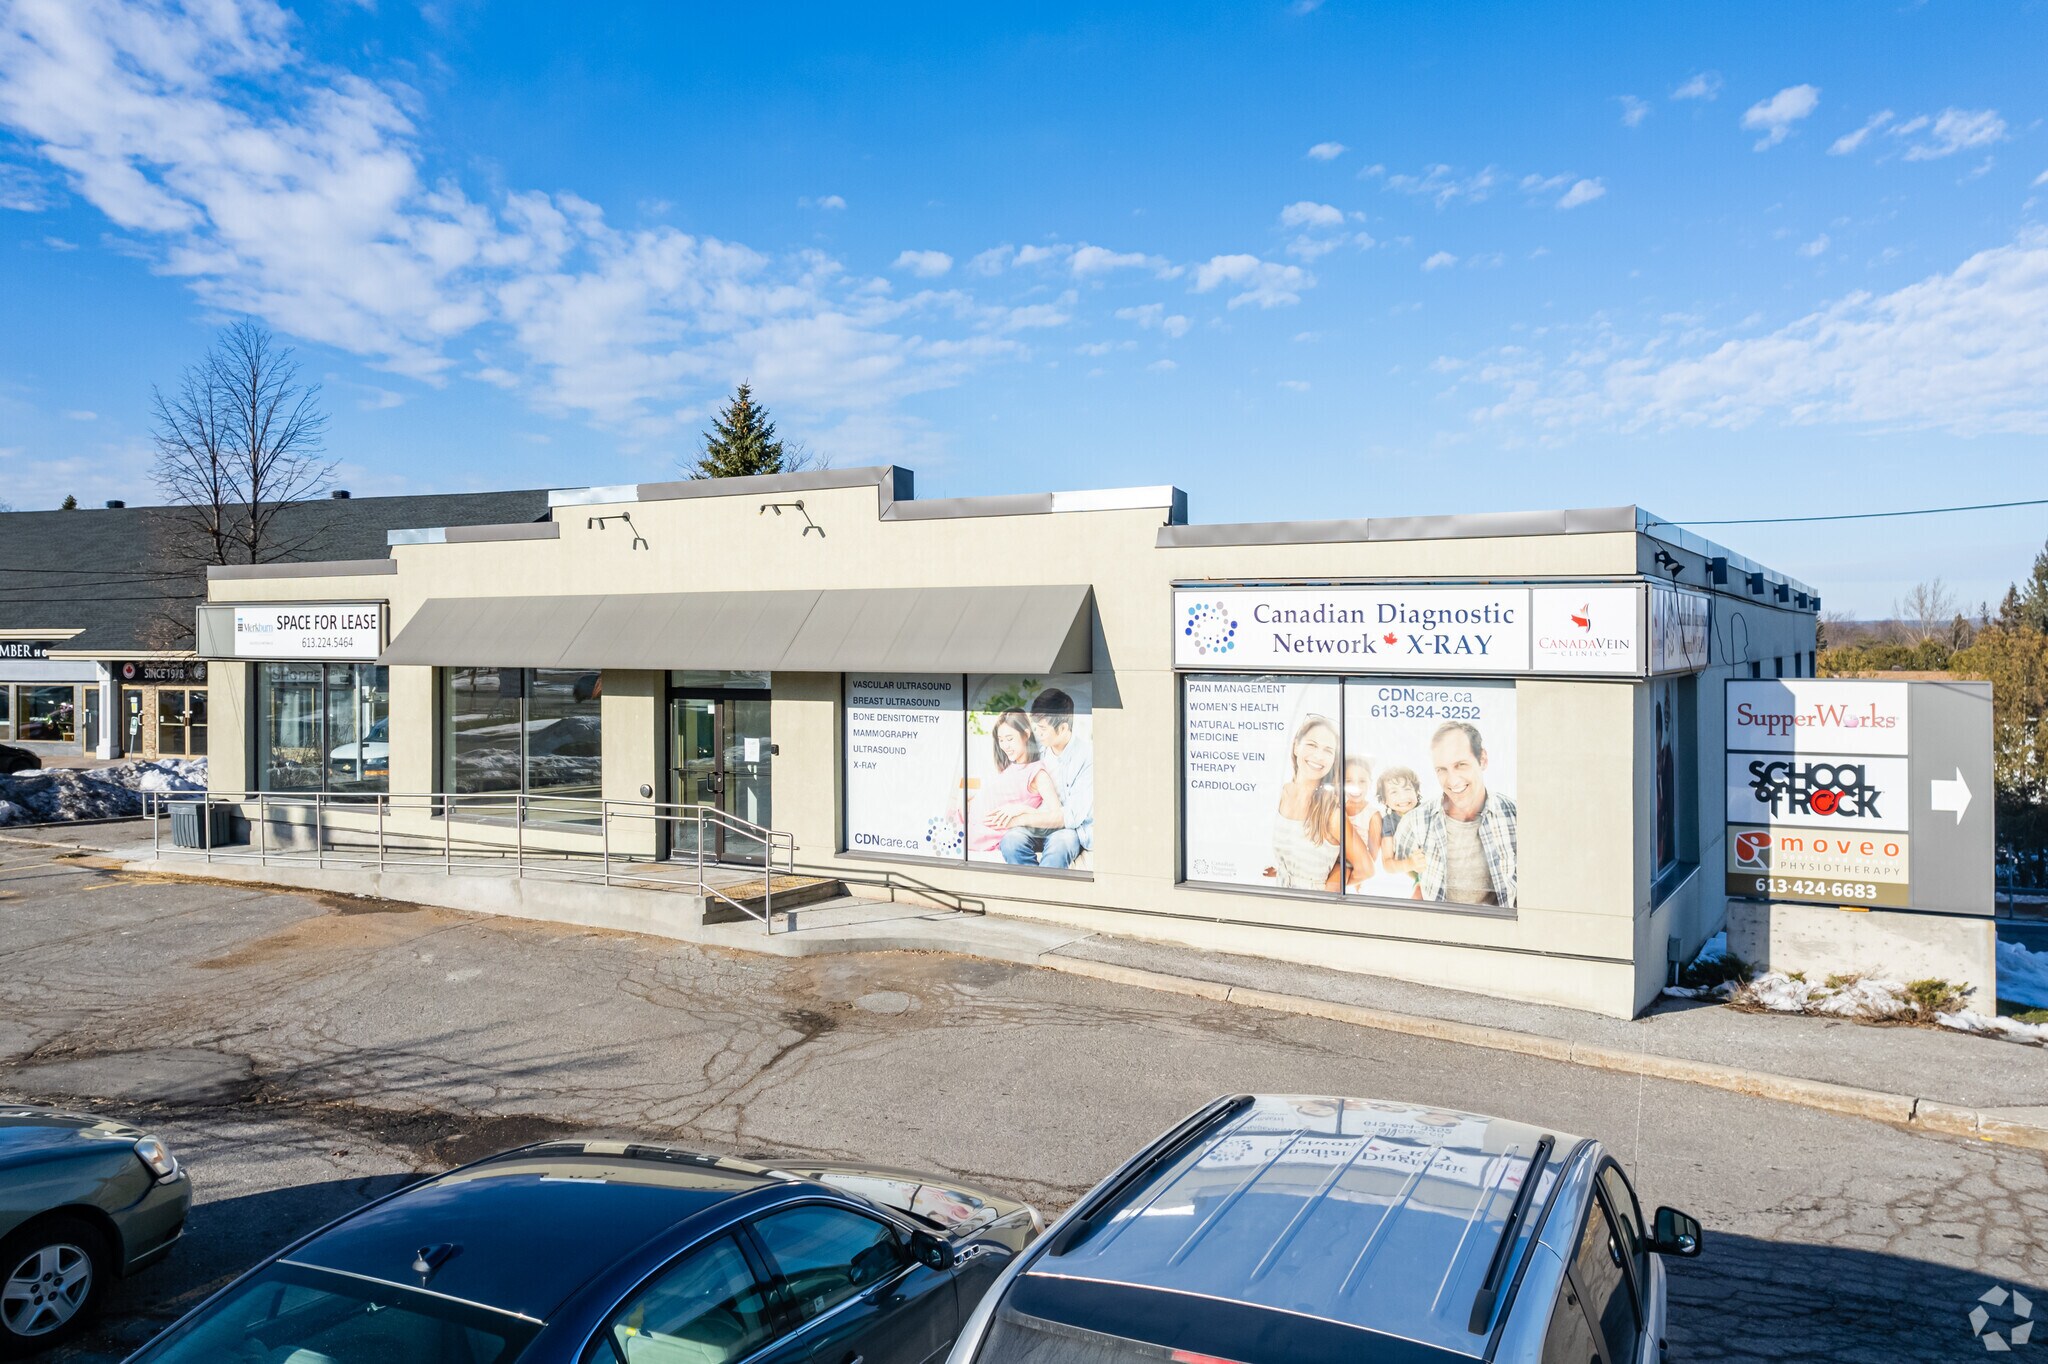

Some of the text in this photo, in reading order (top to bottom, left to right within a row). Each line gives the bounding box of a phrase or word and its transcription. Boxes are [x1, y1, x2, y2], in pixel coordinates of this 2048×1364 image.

[276, 614, 377, 630] SPACE FOR LEASE
[1253, 602, 1515, 631] Canadian Diagnostic
[301, 636, 354, 648] 613.224.5464
[1273, 633, 1493, 655] Network X-RAY
[144, 668, 166, 679] SINCE
[852, 680, 952, 691] VASCULAR ULTRASOUND
[1189, 684, 1287, 694] PAIN MANAGEMENT
[1378, 688, 1473, 703] CDNcare.ca
[852, 696, 941, 707] BREAST ULTRASOUND
[1189, 702, 1279, 712] WOMEN'S HEALTH
[1370, 704, 1481, 720] 613-824-3252
[853, 713, 940, 724] BONE DENSITOMETRY
[1190, 720, 1285, 731] NATURAL HOLISTIC
[853, 729, 919, 739] MAMMOGRAPHY
[1190, 732, 1239, 742] MEDICINE
[853, 745, 907, 755] ULTRASOUND
[1190, 750, 1266, 761] VARICOSE VEIN
[853, 761, 877, 770] X-RAY
[1190, 763, 1237, 773] THERAPY
[1749, 760, 1876, 793] SCHOOL
[1191, 780, 1257, 792] CARDIOLOGY
[854, 832, 919, 850] CDNcare.ca
[1781, 837, 1900, 857] moveo
[1780, 861, 1900, 876] PHYSIOTHERAPY
